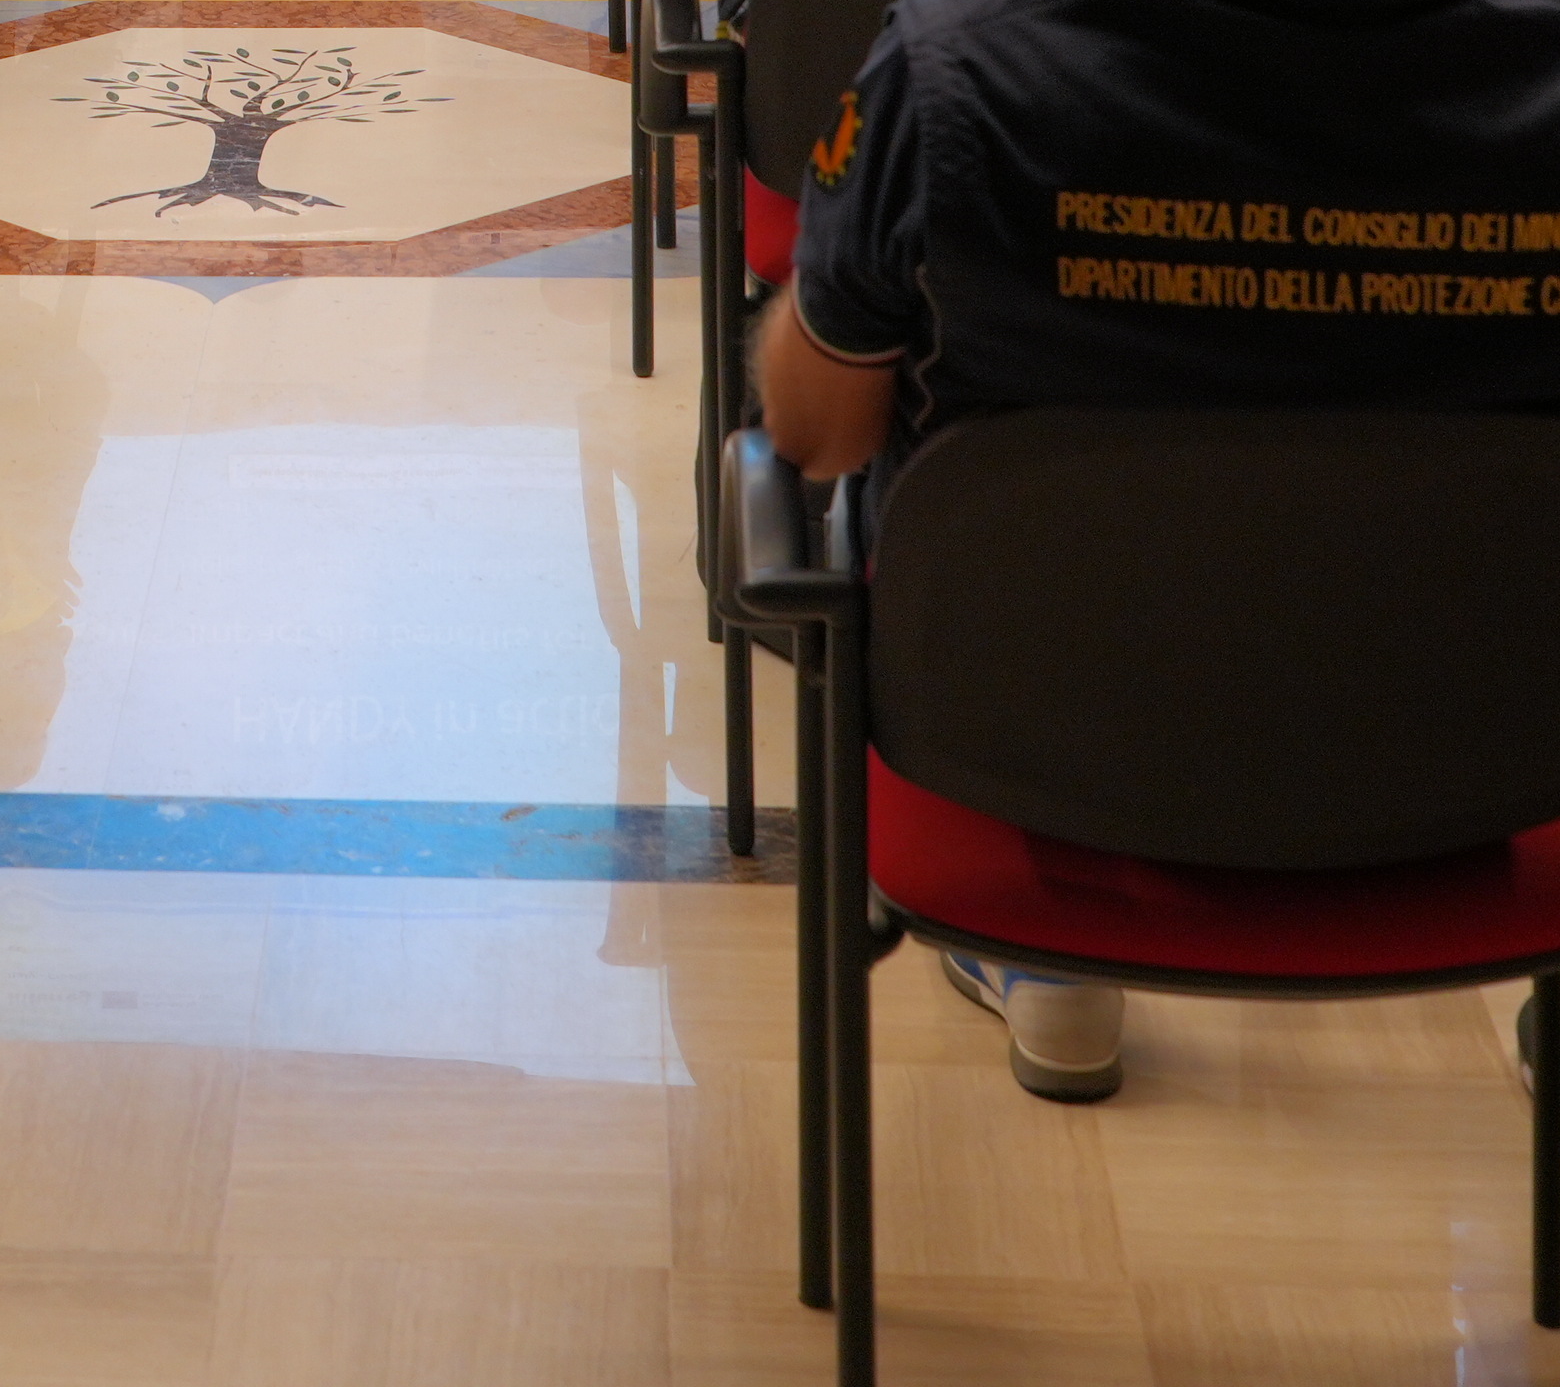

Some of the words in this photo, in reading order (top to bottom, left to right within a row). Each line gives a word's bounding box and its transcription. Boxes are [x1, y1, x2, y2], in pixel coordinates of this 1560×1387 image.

[1056, 190, 1235, 241] PRESIDENZA
[1240, 201, 1296, 244] DEL
[1301, 206, 1455, 251] CONSIGLIO
[1461, 212, 1508, 252] DEI
[1057, 256, 1259, 309] DIPARTIMENTO
[1263, 268, 1356, 314] DELLA
[1360, 271, 1535, 316] PROTEZIONE
